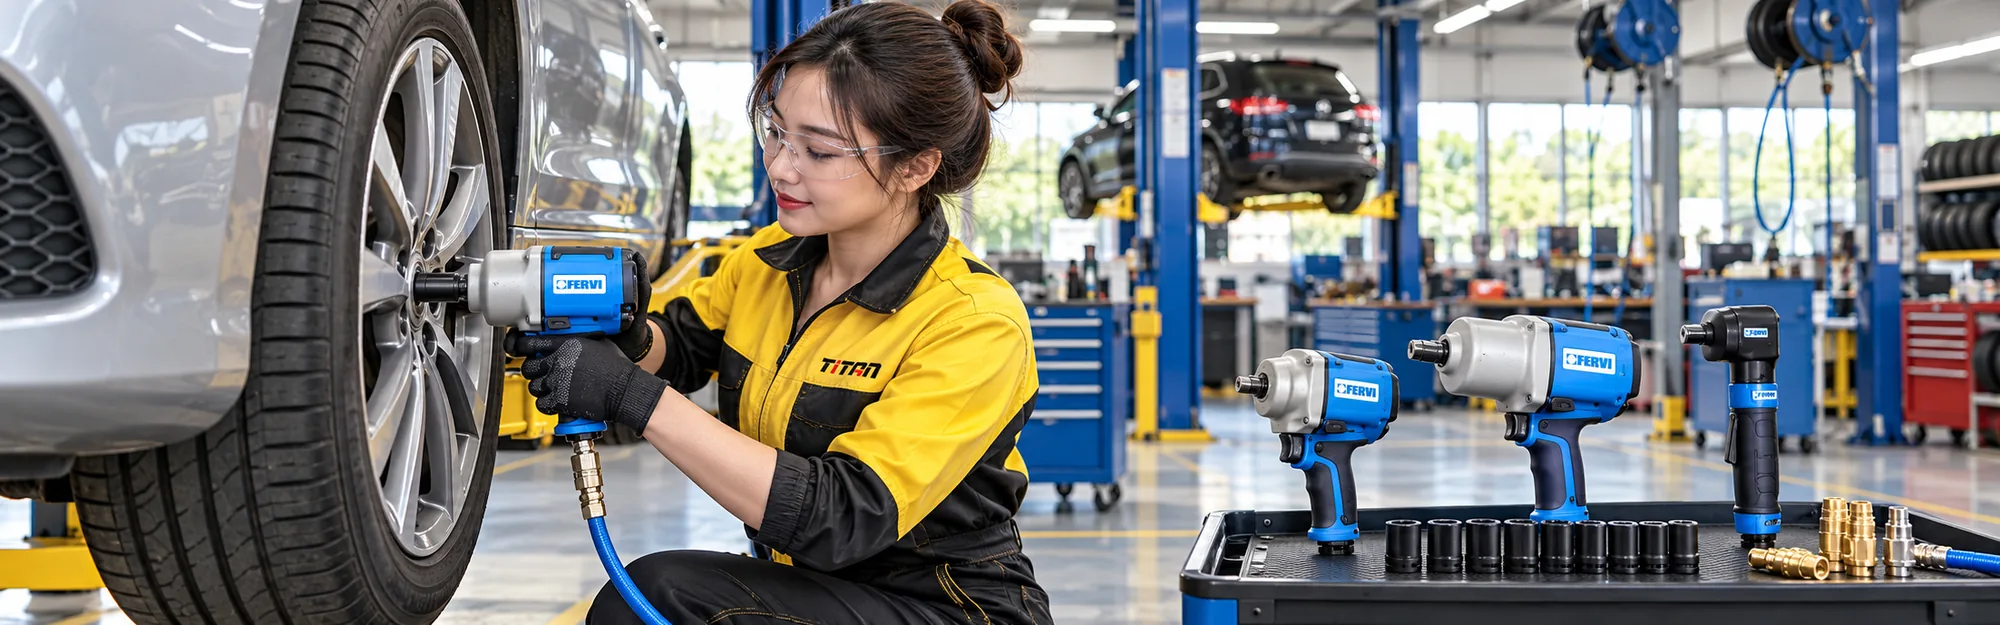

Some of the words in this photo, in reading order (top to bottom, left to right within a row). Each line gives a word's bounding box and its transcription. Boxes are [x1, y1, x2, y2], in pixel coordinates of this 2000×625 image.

[567, 280, 602, 289] FERVI
[1577, 355, 1612, 369] FERVI
[1346, 384, 1377, 398] FERVI
